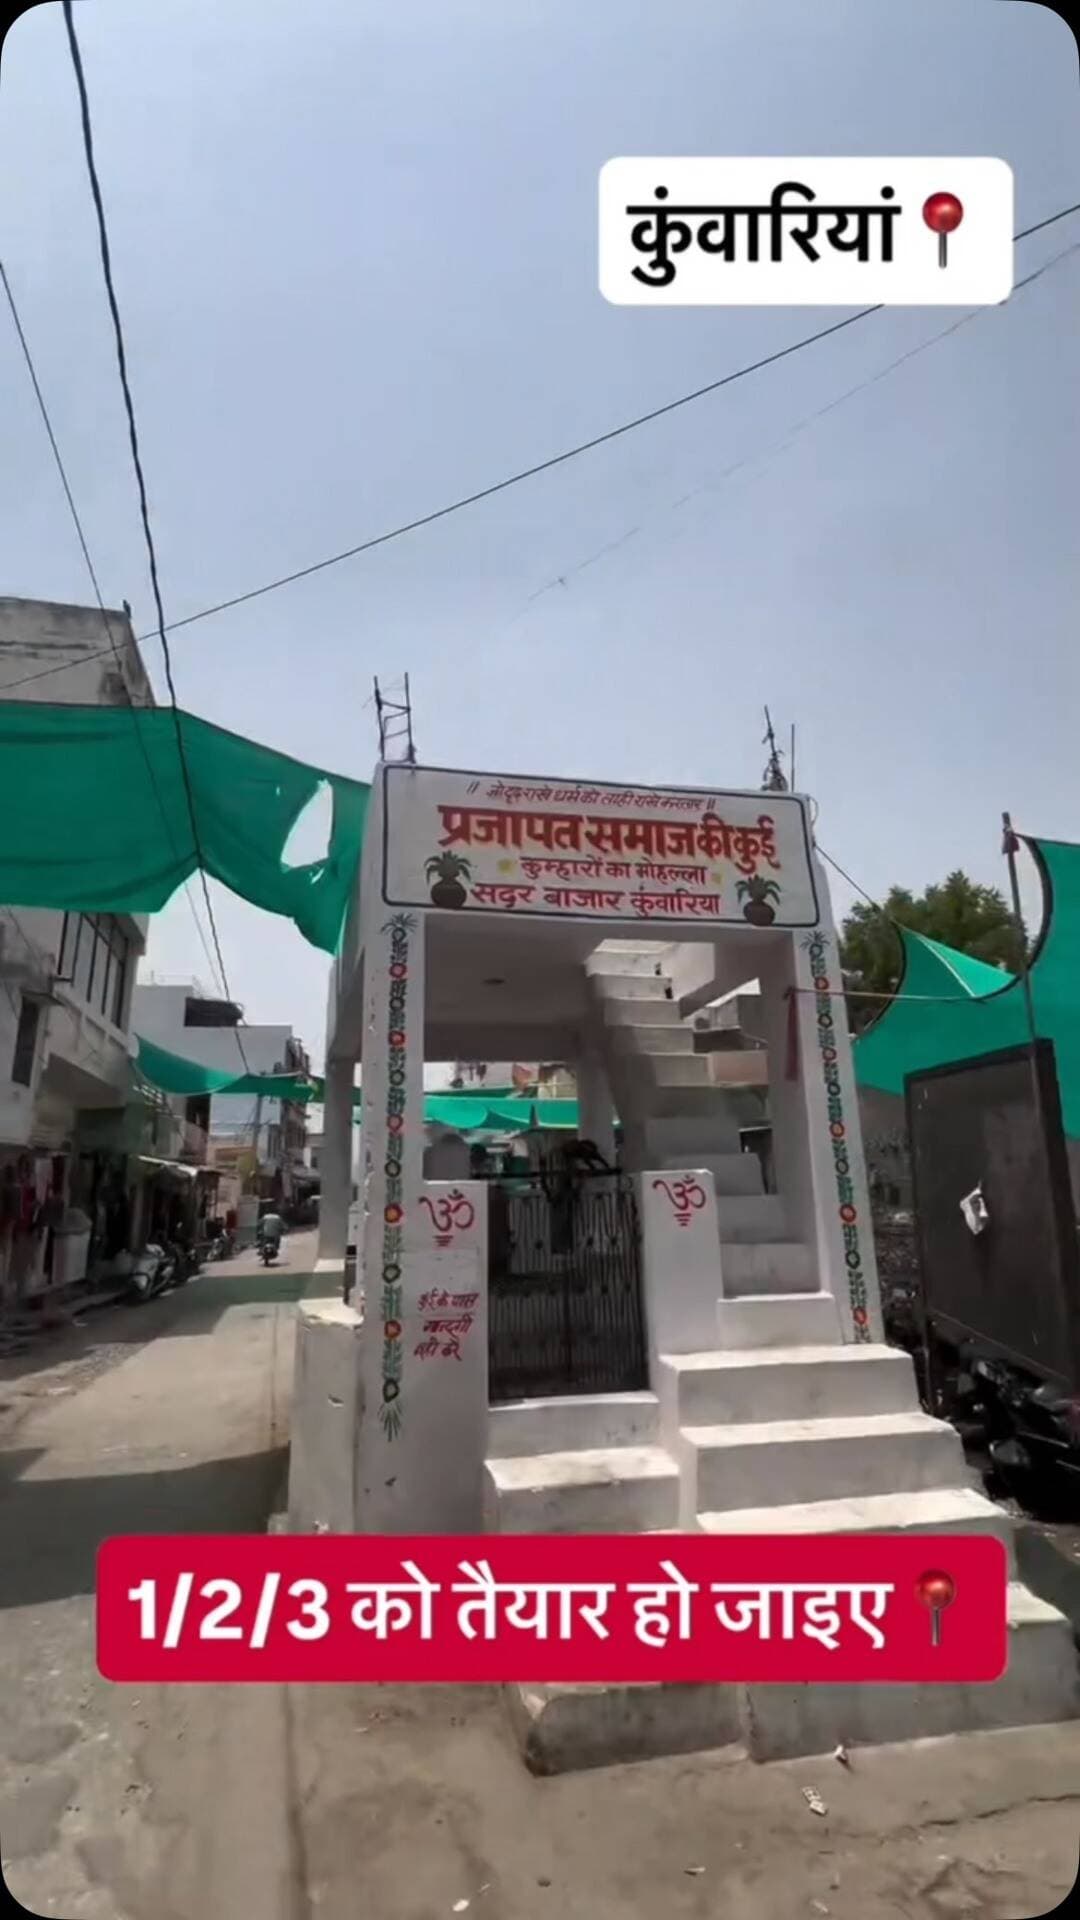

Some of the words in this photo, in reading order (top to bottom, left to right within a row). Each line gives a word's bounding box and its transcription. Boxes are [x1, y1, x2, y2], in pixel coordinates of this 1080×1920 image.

[437, 804, 585, 852] प्रजापत
[585, 815, 698, 859] समाज
[697, 811, 734, 860] की
[733, 814, 781, 875] कुई
[605, 861, 631, 879] का
[634, 856, 708, 885] मोहल्ला
[543, 886, 625, 910] बाजार
[629, 885, 721, 917] कुंवारिया
